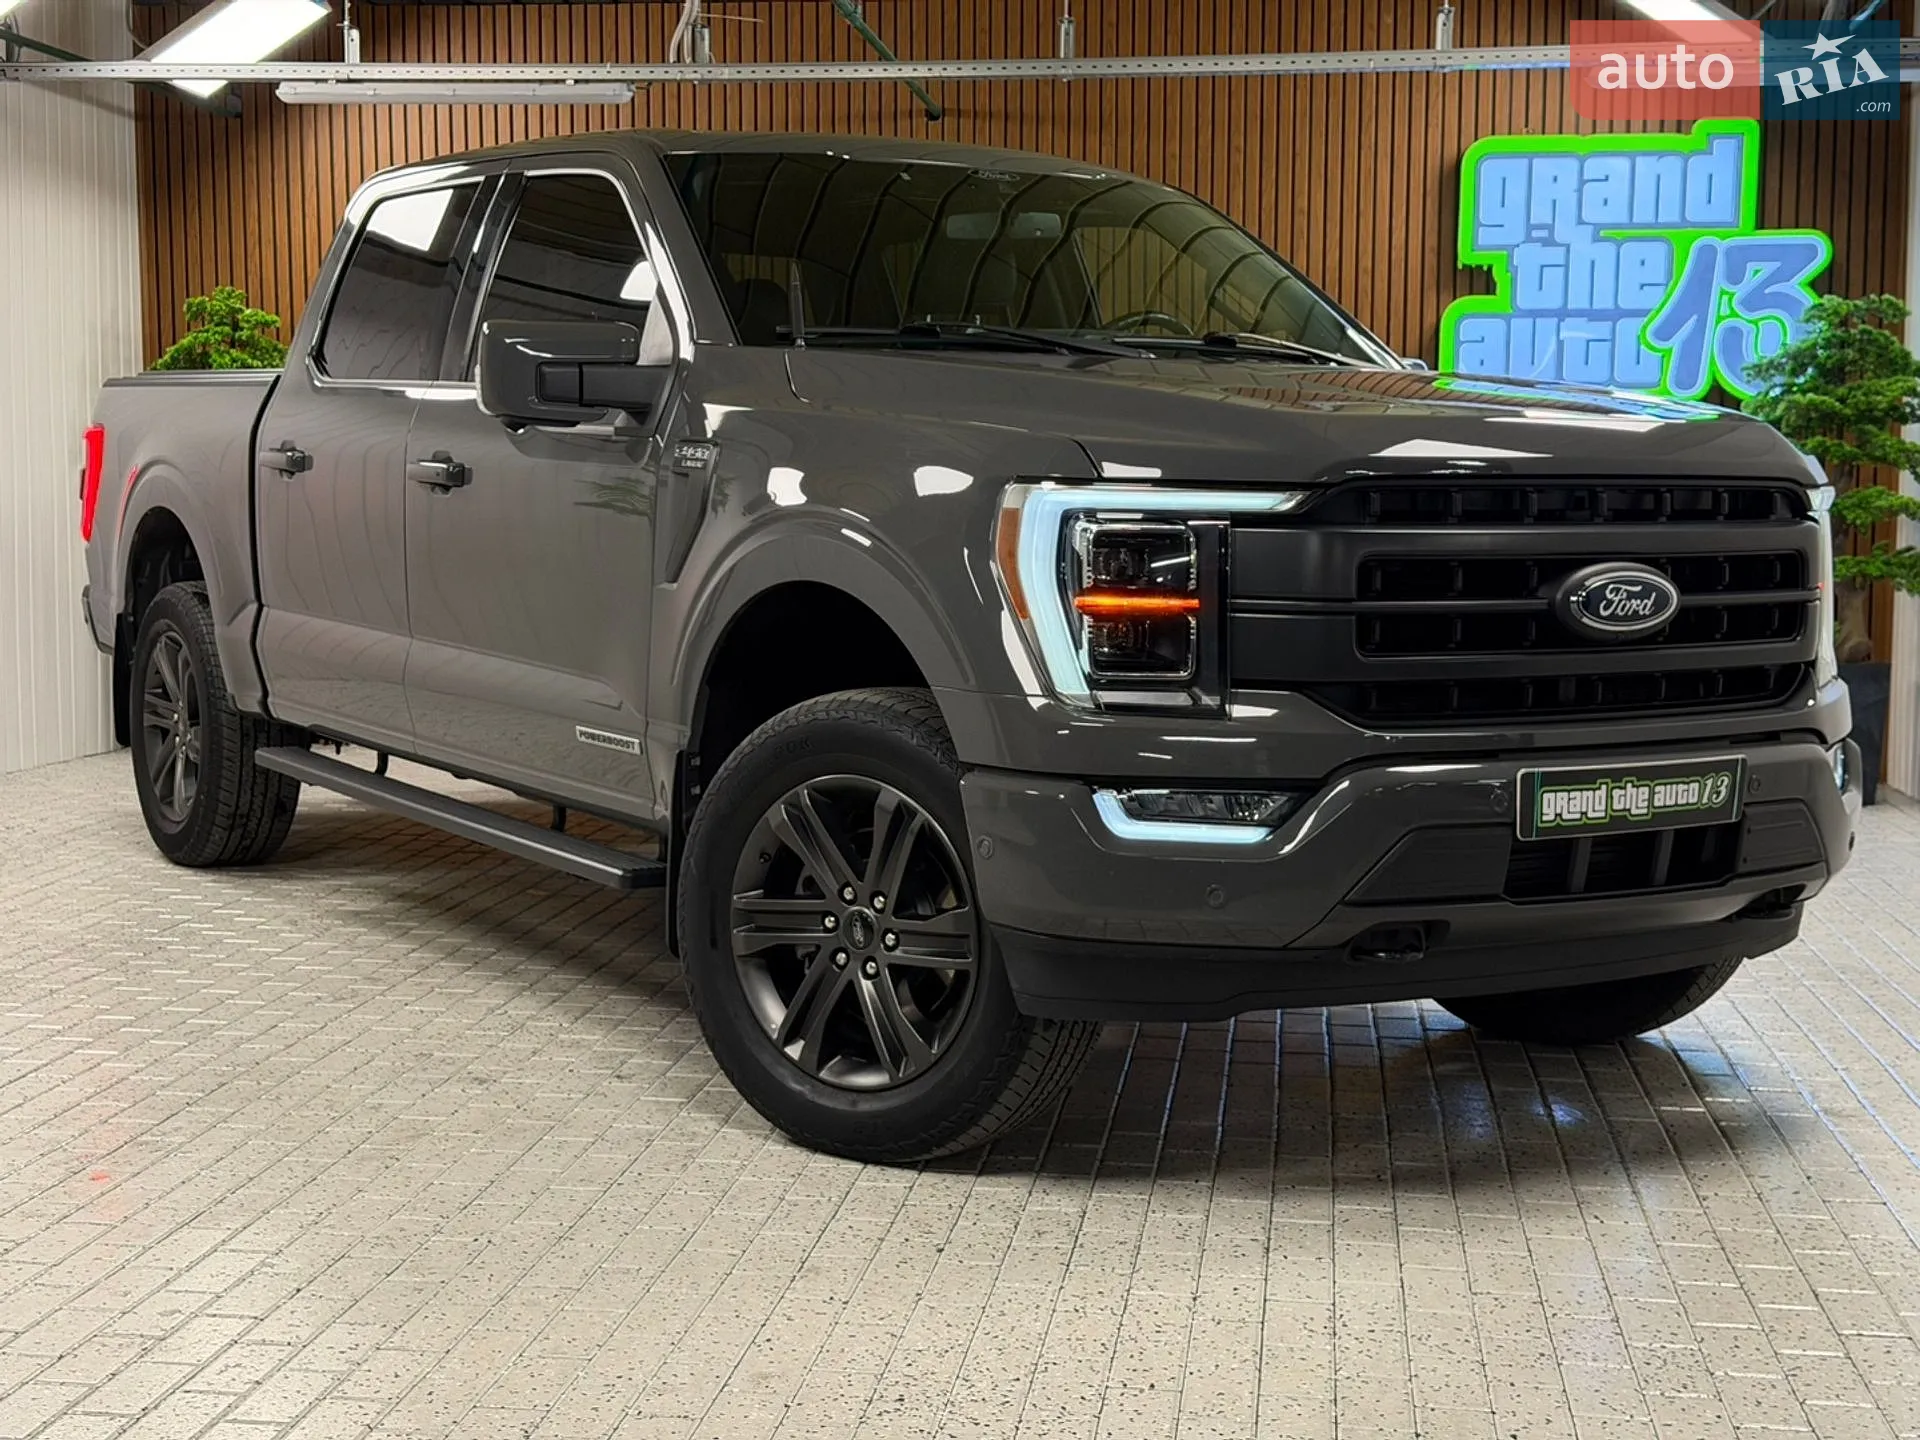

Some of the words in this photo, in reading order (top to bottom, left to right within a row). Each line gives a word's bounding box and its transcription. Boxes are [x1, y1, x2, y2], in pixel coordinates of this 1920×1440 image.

[1514, 228, 1672, 310] the
[1599, 583, 1656, 616] Ford
[1542, 784, 1607, 821] grand
[1612, 782, 1649, 815] the
